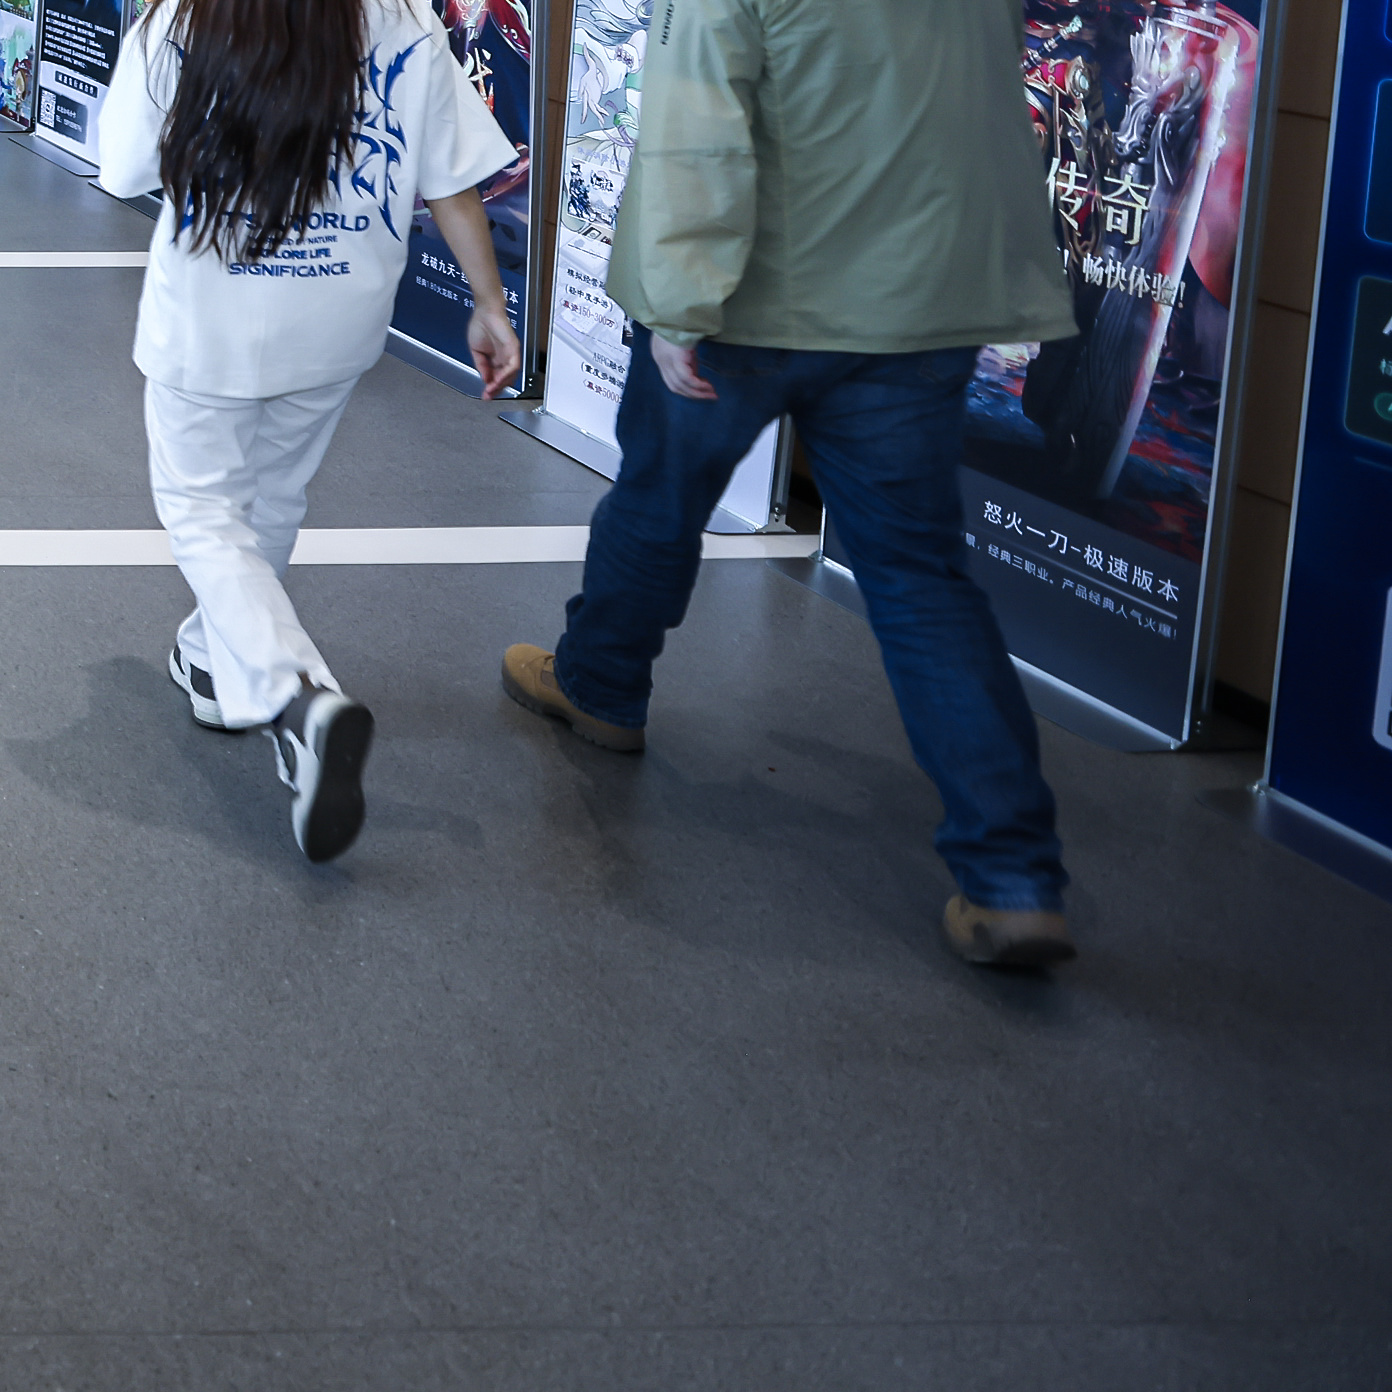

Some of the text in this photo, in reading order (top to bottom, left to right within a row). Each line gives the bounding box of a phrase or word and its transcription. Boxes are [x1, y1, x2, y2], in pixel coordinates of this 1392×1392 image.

[1046, 157, 1151, 245] 传奇
[229, 262, 351, 278] SIGNIFICANCE
[310, 248, 332, 258] LIFE
[983, 500, 1179, 602] 怒火一刀-极速版本
